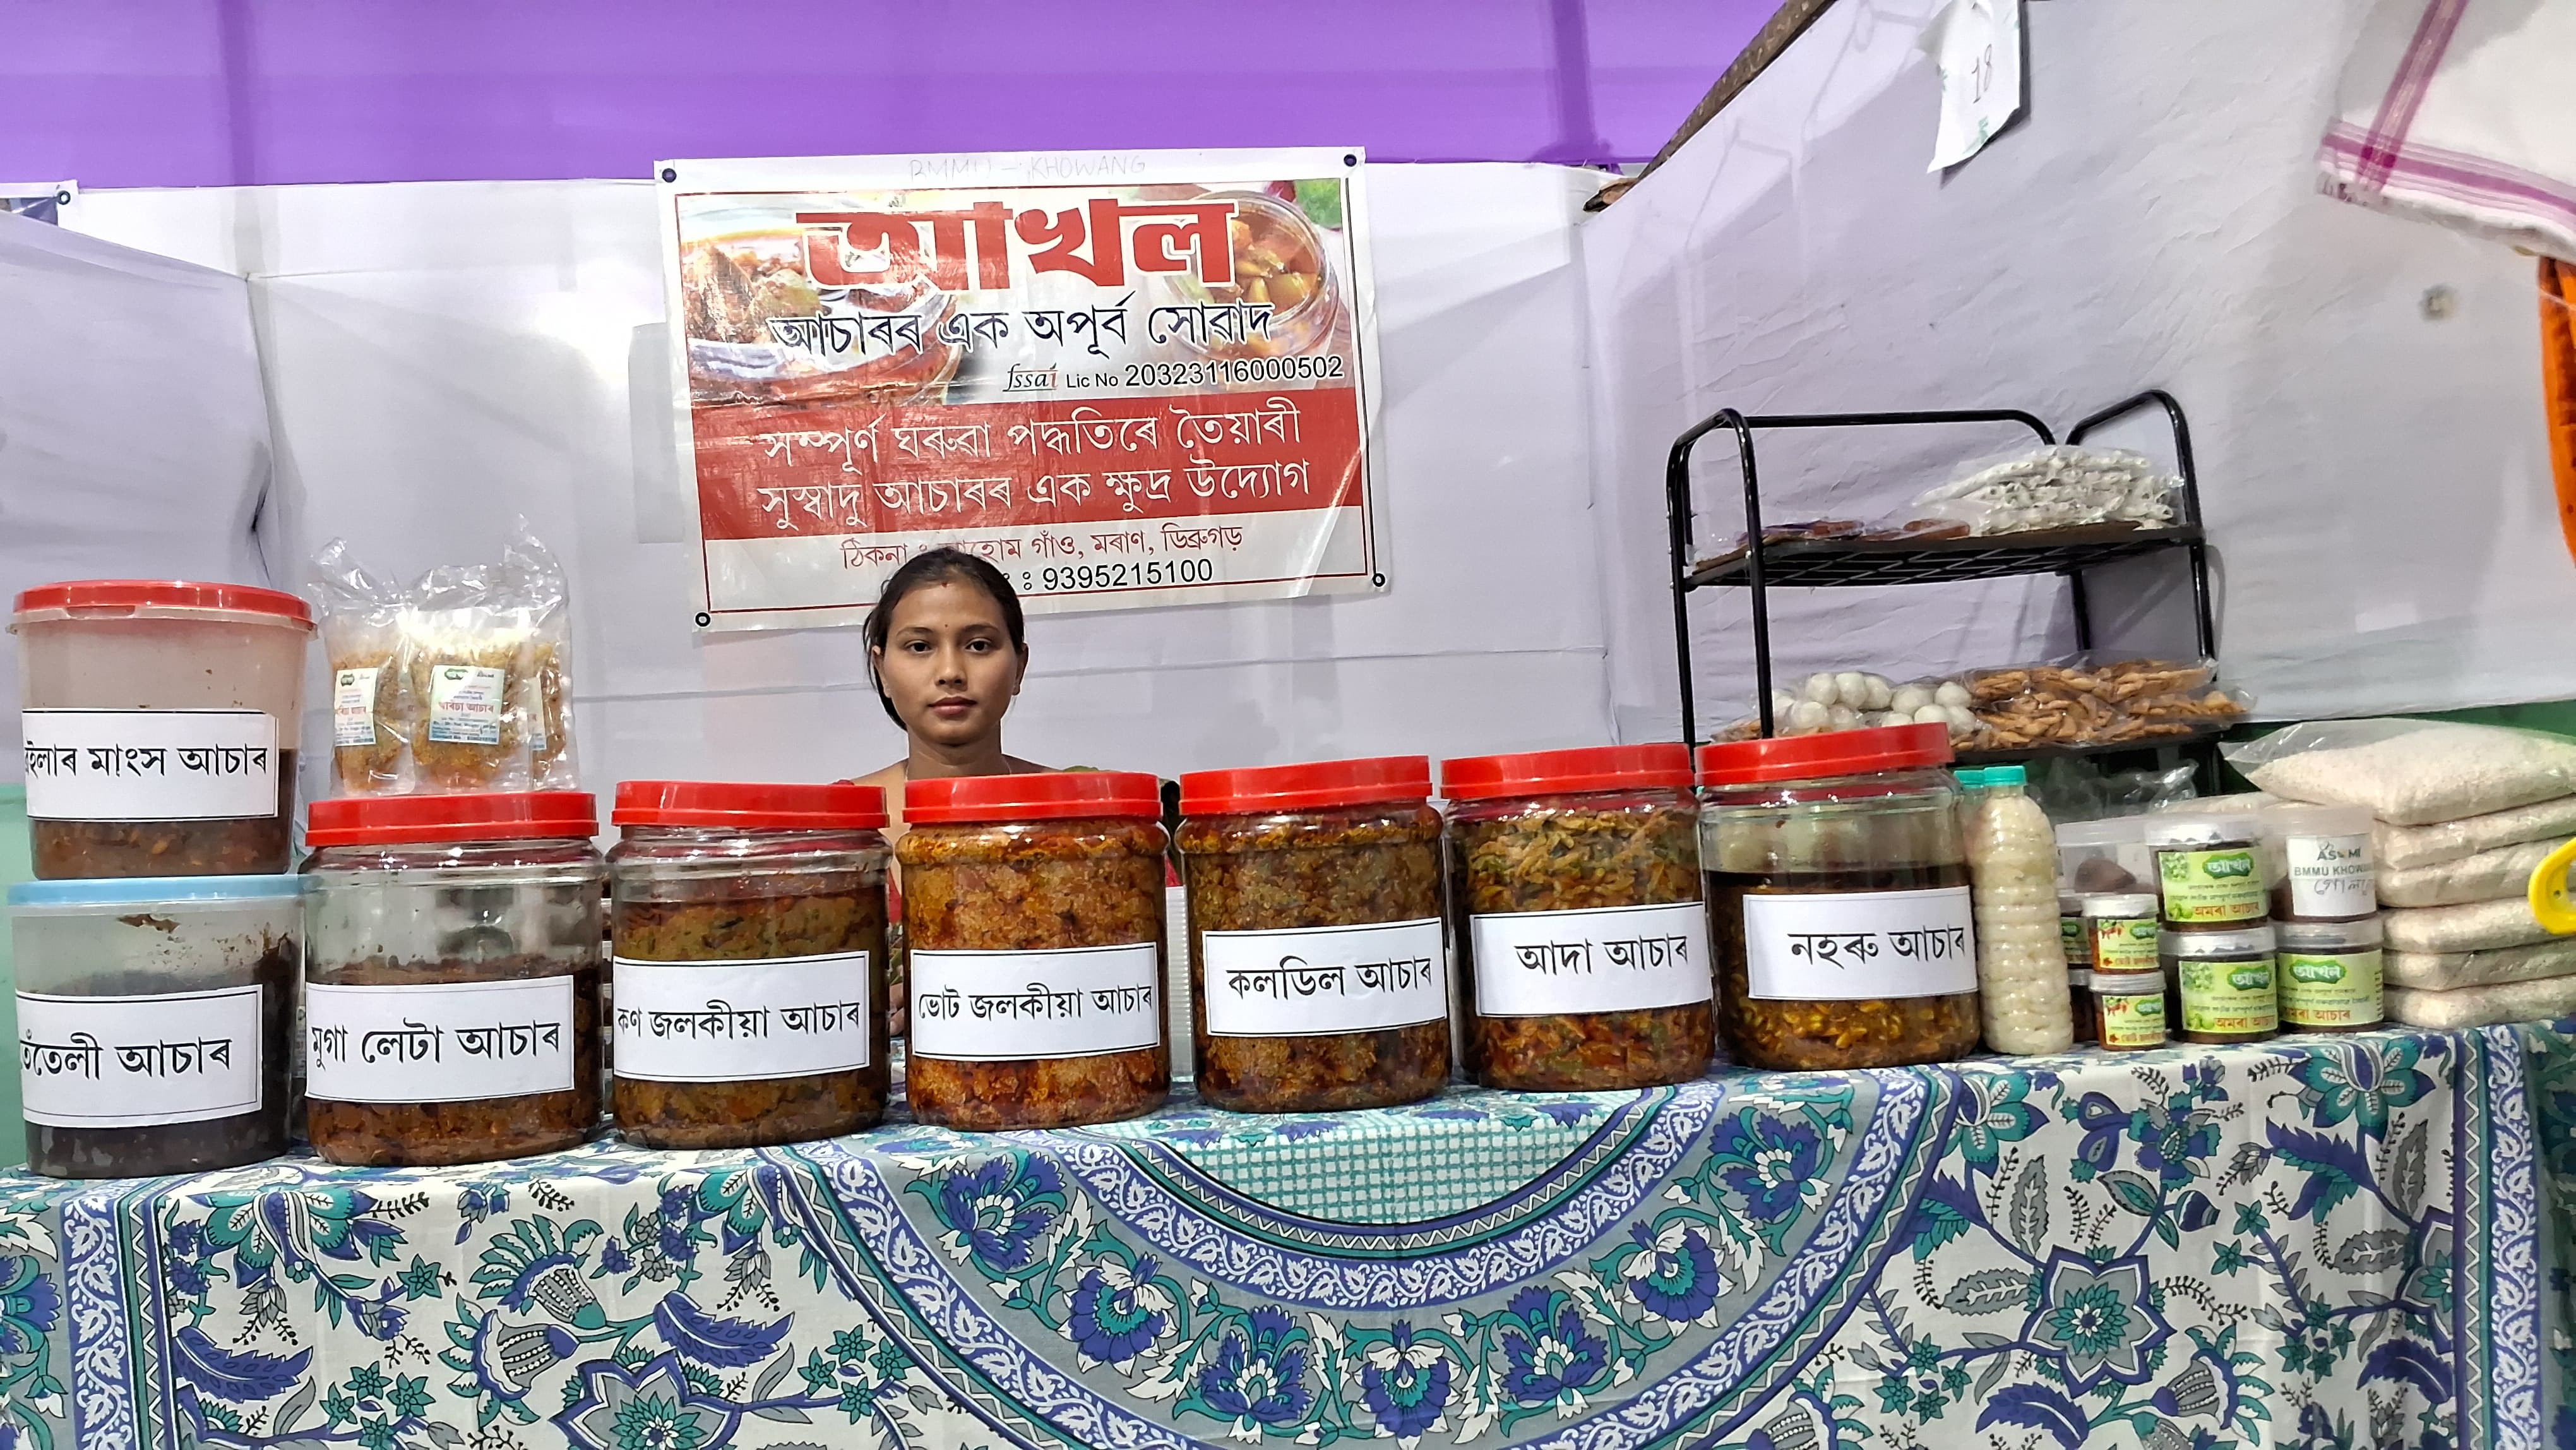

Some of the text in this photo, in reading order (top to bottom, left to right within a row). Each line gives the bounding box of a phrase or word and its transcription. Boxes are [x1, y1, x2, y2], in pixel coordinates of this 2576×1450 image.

[1029, 155, 1146, 180] KHOWANG
[796, 198, 1236, 291] আখল
[766, 311, 923, 356] আচাৰৰ
[938, 312, 1010, 352] এক
[1148, 300, 1275, 346] সোৱাদ
[1003, 355, 1344, 392] fssai Lic No 20323116000502
[759, 413, 887, 476] সম্পূৰ্ণ
[891, 421, 992, 460] ঘৰুৱা
[1008, 406, 1159, 457] পদ্ধতিৰে
[757, 482, 868, 531] সুস্বাদু
[873, 477, 1013, 515] আচাৰৰ
[1027, 472, 1091, 507] এক
[840, 537, 909, 569] ঠিকনা
[1042, 558, 1213, 591] 9395215100
[86, 743, 168, 777] মাংস
[177, 743, 268, 777] আচাৰ
[2294, 866, 2329, 877] BMMU
[1514, 932, 1688, 976] আদা আচাৰ
[1787, 923, 1965, 970] নহৰু আচাৰ
[1225, 955, 1431, 1000] কলডিল আচাৰ
[648, 999, 771, 1040] জলকীয়া
[779, 1000, 861, 1034] আচাৰ
[919, 982, 1153, 1021] ভোট জলকীয়া আচাৰ
[114, 1036, 233, 1078] আচাৰ
[311, 1017, 561, 1071] মুগা লেটা আচাৰ
